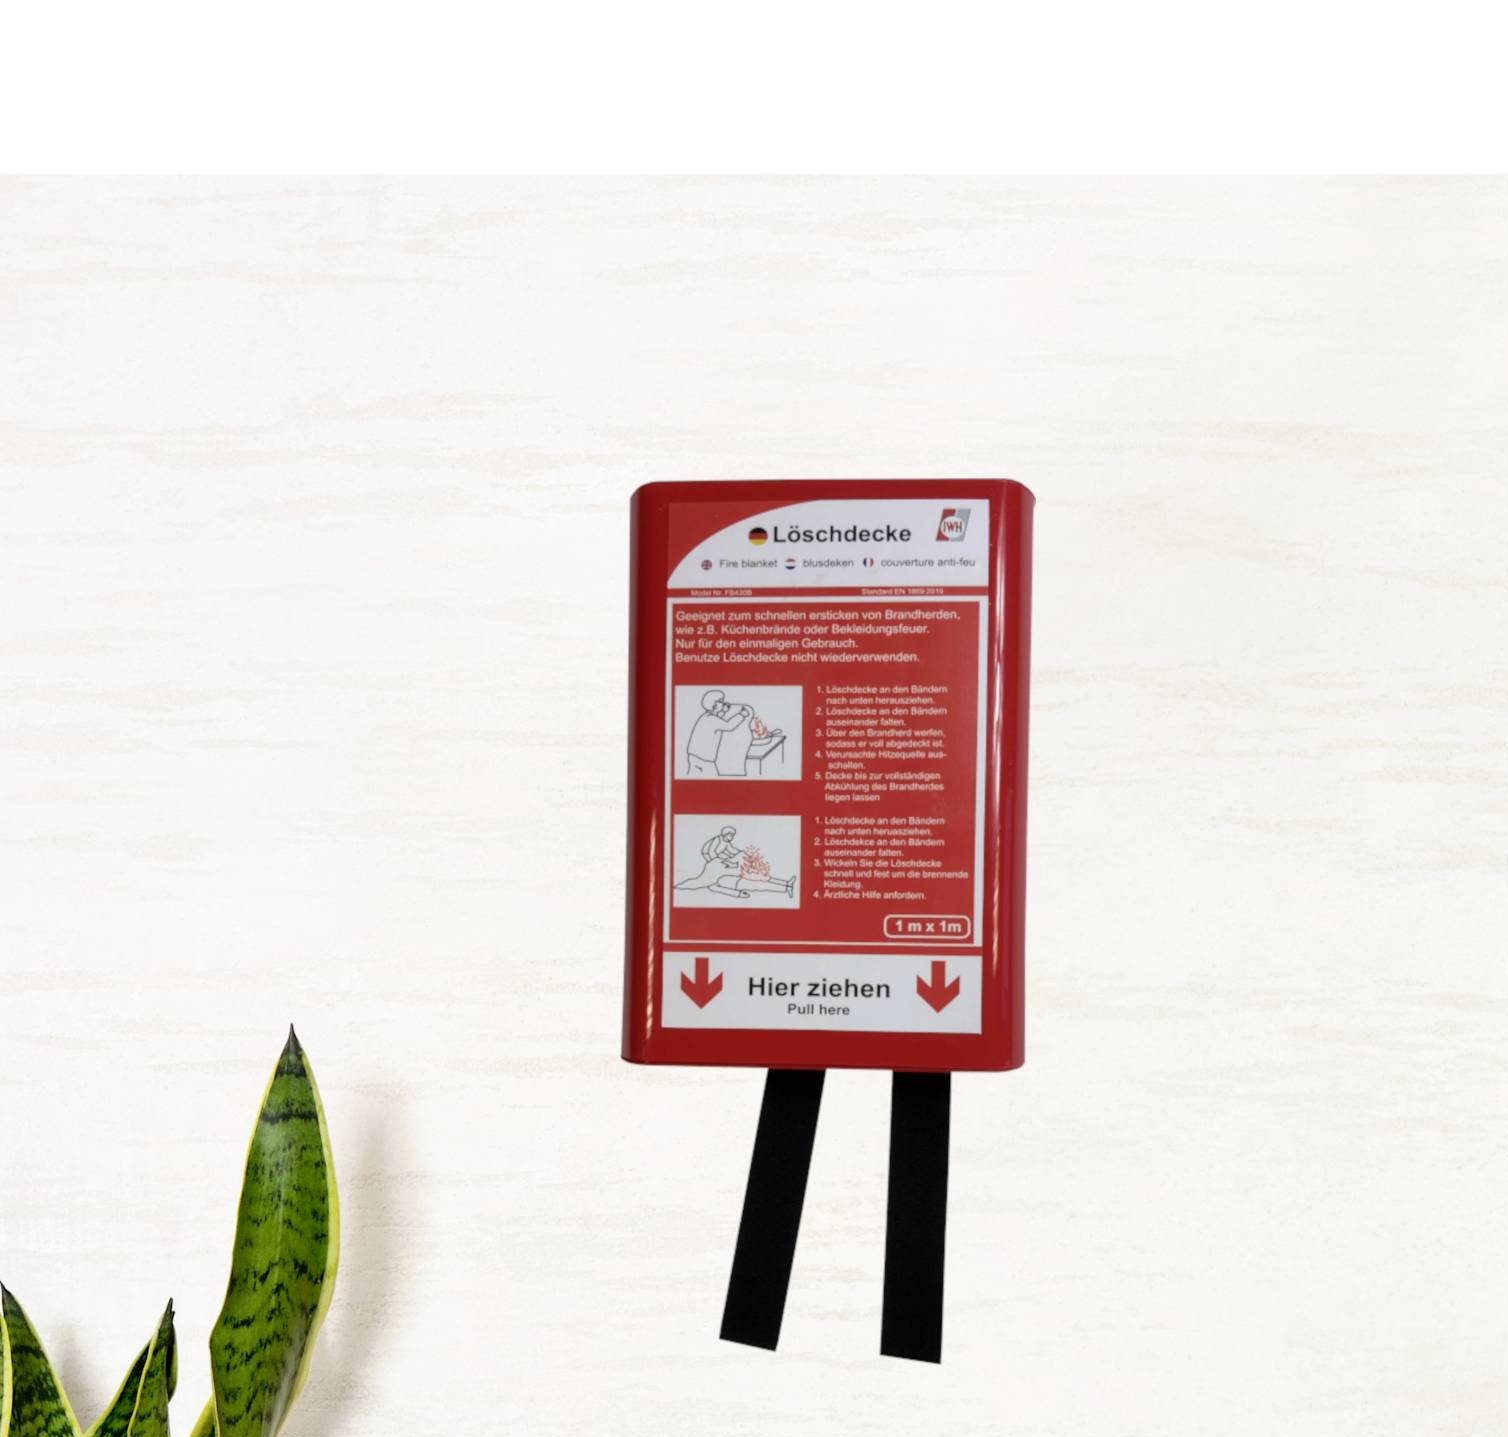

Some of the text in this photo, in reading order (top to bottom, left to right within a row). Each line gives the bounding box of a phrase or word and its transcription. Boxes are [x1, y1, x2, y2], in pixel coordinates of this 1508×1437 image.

[943, 518, 963, 534] IWH
[773, 525, 911, 543] Löschdecke
[719, 558, 976, 568] Fire blanket blusdeken couverture anti-feu
[675, 610, 960, 622] Geeignet zum schnellen ersticken von Brandherden,
[675, 624, 929, 636] wie z.B. Küchenbrände oder Bekleidungsfeuer.
[675, 638, 858, 651] Nur für den einmaligen Gebrauch.
[675, 652, 919, 663] Benutze Löschdecke nicht wiederverwenden.
[826, 686, 877, 694] Löschdecke
[892, 686, 909, 694] den
[911, 686, 947, 694] Bändern
[911, 707, 947, 715] Bändern
[826, 718, 878, 726] auseinander
[826, 728, 846, 737] Über
[848, 729, 866, 737] den
[867, 729, 912, 737] Brandherd
[826, 740, 856, 748] sodass
[869, 740, 884, 748] voll
[886, 740, 930, 749] abgedeckt
[932, 740, 944, 748] ist.
[826, 750, 876, 758] Verursachte
[878, 750, 925, 759] Hitzequelle
[828, 761, 865, 769] schalten.
[825, 772, 853, 780] Decke
[855, 772, 868, 780] bis
[885, 772, 940, 781] vollständigen
[825, 782, 869, 792] Abkühlung
[825, 793, 880, 803] liegen lassen
[890, 838, 906, 846] den
[909, 838, 945, 846] Bändern
[824, 859, 857, 867] Wickeln
[860, 859, 873, 867] Sie
[875, 859, 888, 867] die
[891, 859, 941, 867] Löschdecke
[824, 870, 854, 878] schnell
[856, 870, 872, 878] und
[874, 870, 889, 878] fest
[907, 870, 920, 878] die
[923, 870, 968, 878] brennende
[824, 880, 862, 889] Kleidung.
[824, 890, 860, 899] Ärztliche
[862, 891, 881, 899] Hilfe
[896, 921, 961, 932] 1 m x 1m
[748, 977, 891, 998] Hier ziehen
[787, 1004, 850, 1015] Pull here
